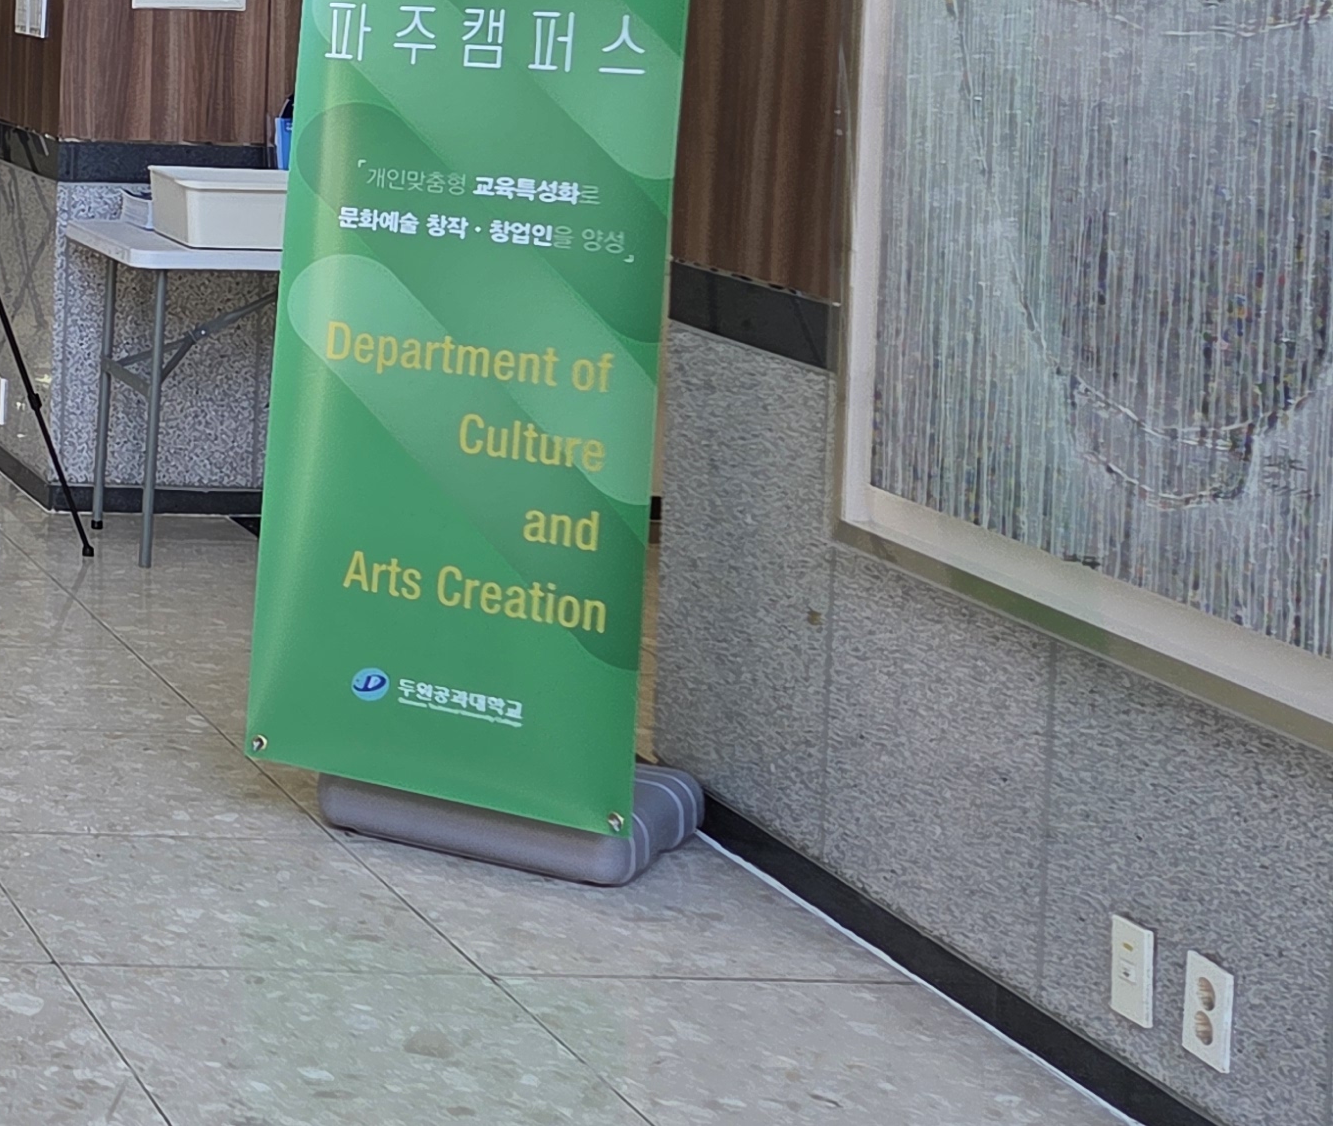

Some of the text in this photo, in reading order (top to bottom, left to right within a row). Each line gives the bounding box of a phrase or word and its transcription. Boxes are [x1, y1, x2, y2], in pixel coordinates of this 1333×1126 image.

[472, 176, 601, 206] 교육특성화로
[338, 206, 419, 234] 문화예술
[426, 214, 469, 240] 창작
[489, 219, 573, 249] 창업인을
[326, 321, 615, 393] Department of
[458, 413, 605, 472] Culture
[523, 510, 600, 552] and
[343, 550, 608, 634] Arts Creation
[397, 678, 524, 719] 두원공과대학교
